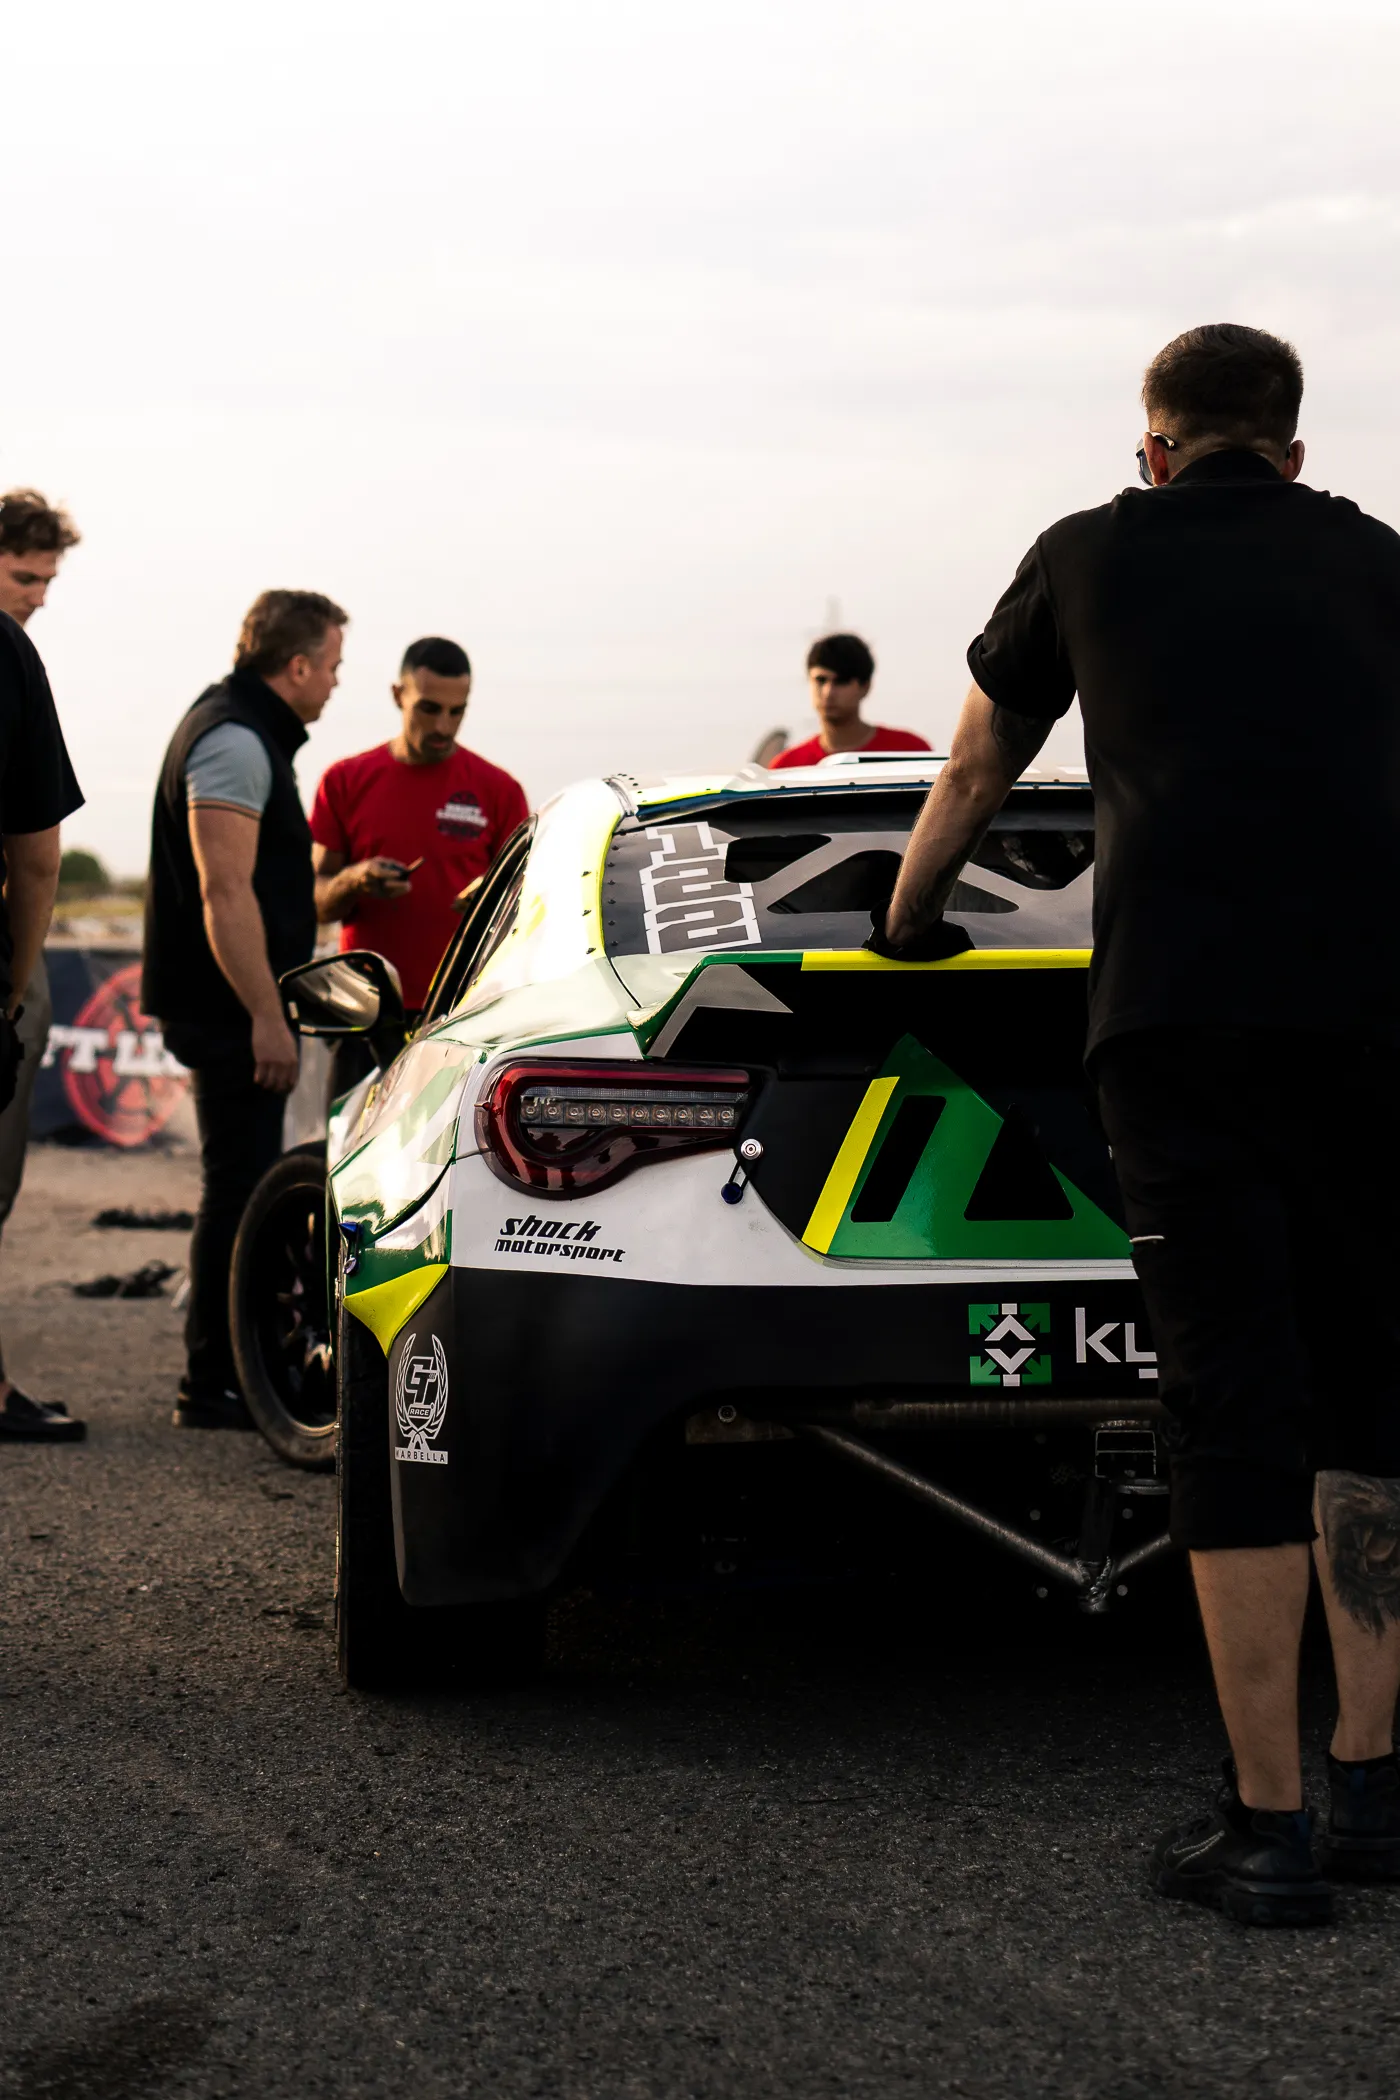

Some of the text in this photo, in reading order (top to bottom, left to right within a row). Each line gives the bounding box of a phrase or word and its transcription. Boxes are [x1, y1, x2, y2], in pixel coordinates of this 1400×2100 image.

[500, 1214, 602, 1242] shock
[494, 1238, 626, 1263] motorsport
[409, 1408, 430, 1416] RACE
